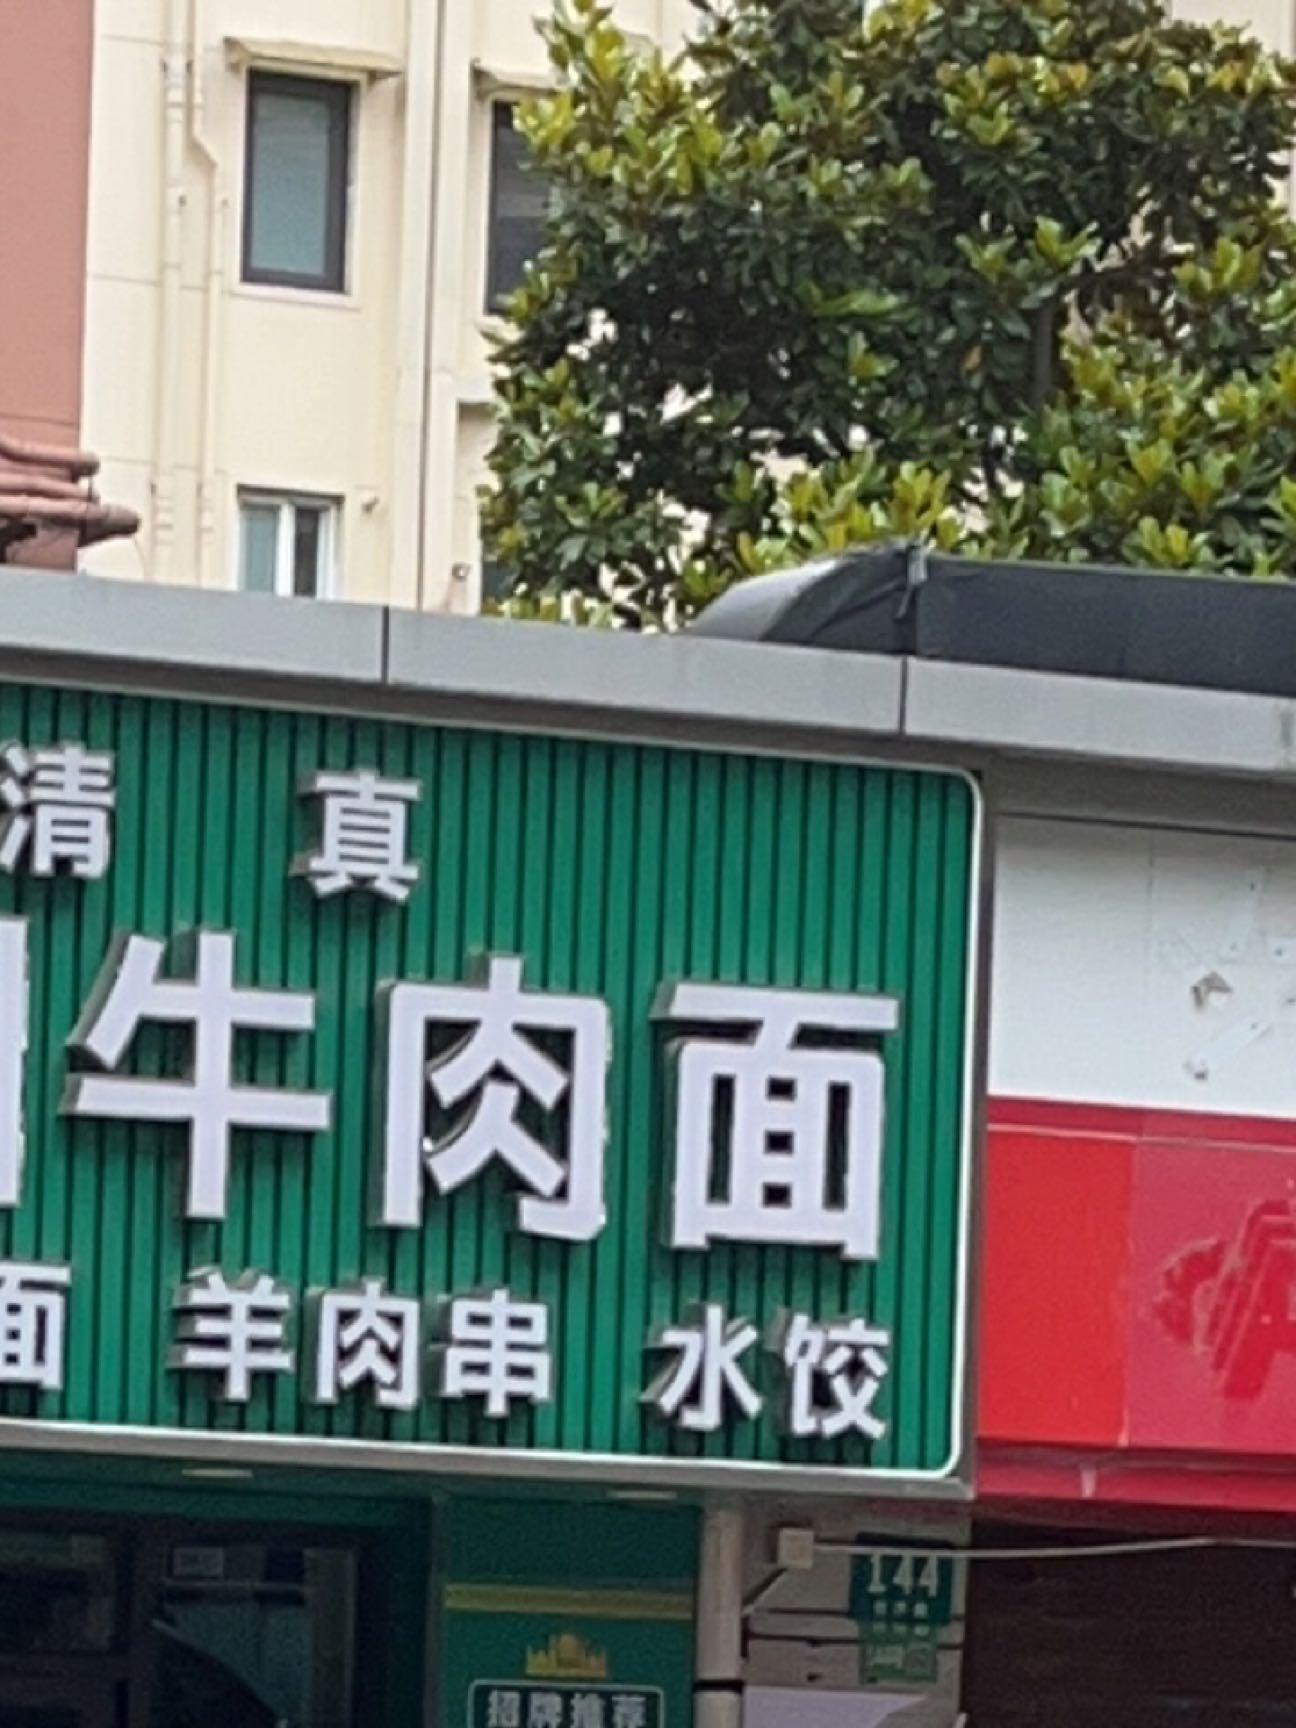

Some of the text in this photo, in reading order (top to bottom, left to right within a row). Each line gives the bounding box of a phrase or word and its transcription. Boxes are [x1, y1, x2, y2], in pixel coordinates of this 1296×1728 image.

[171, 1265, 551, 1416] 羊肉串
[643, 1302, 891, 1439] 水饺
[866, 1552, 939, 1597] 144
